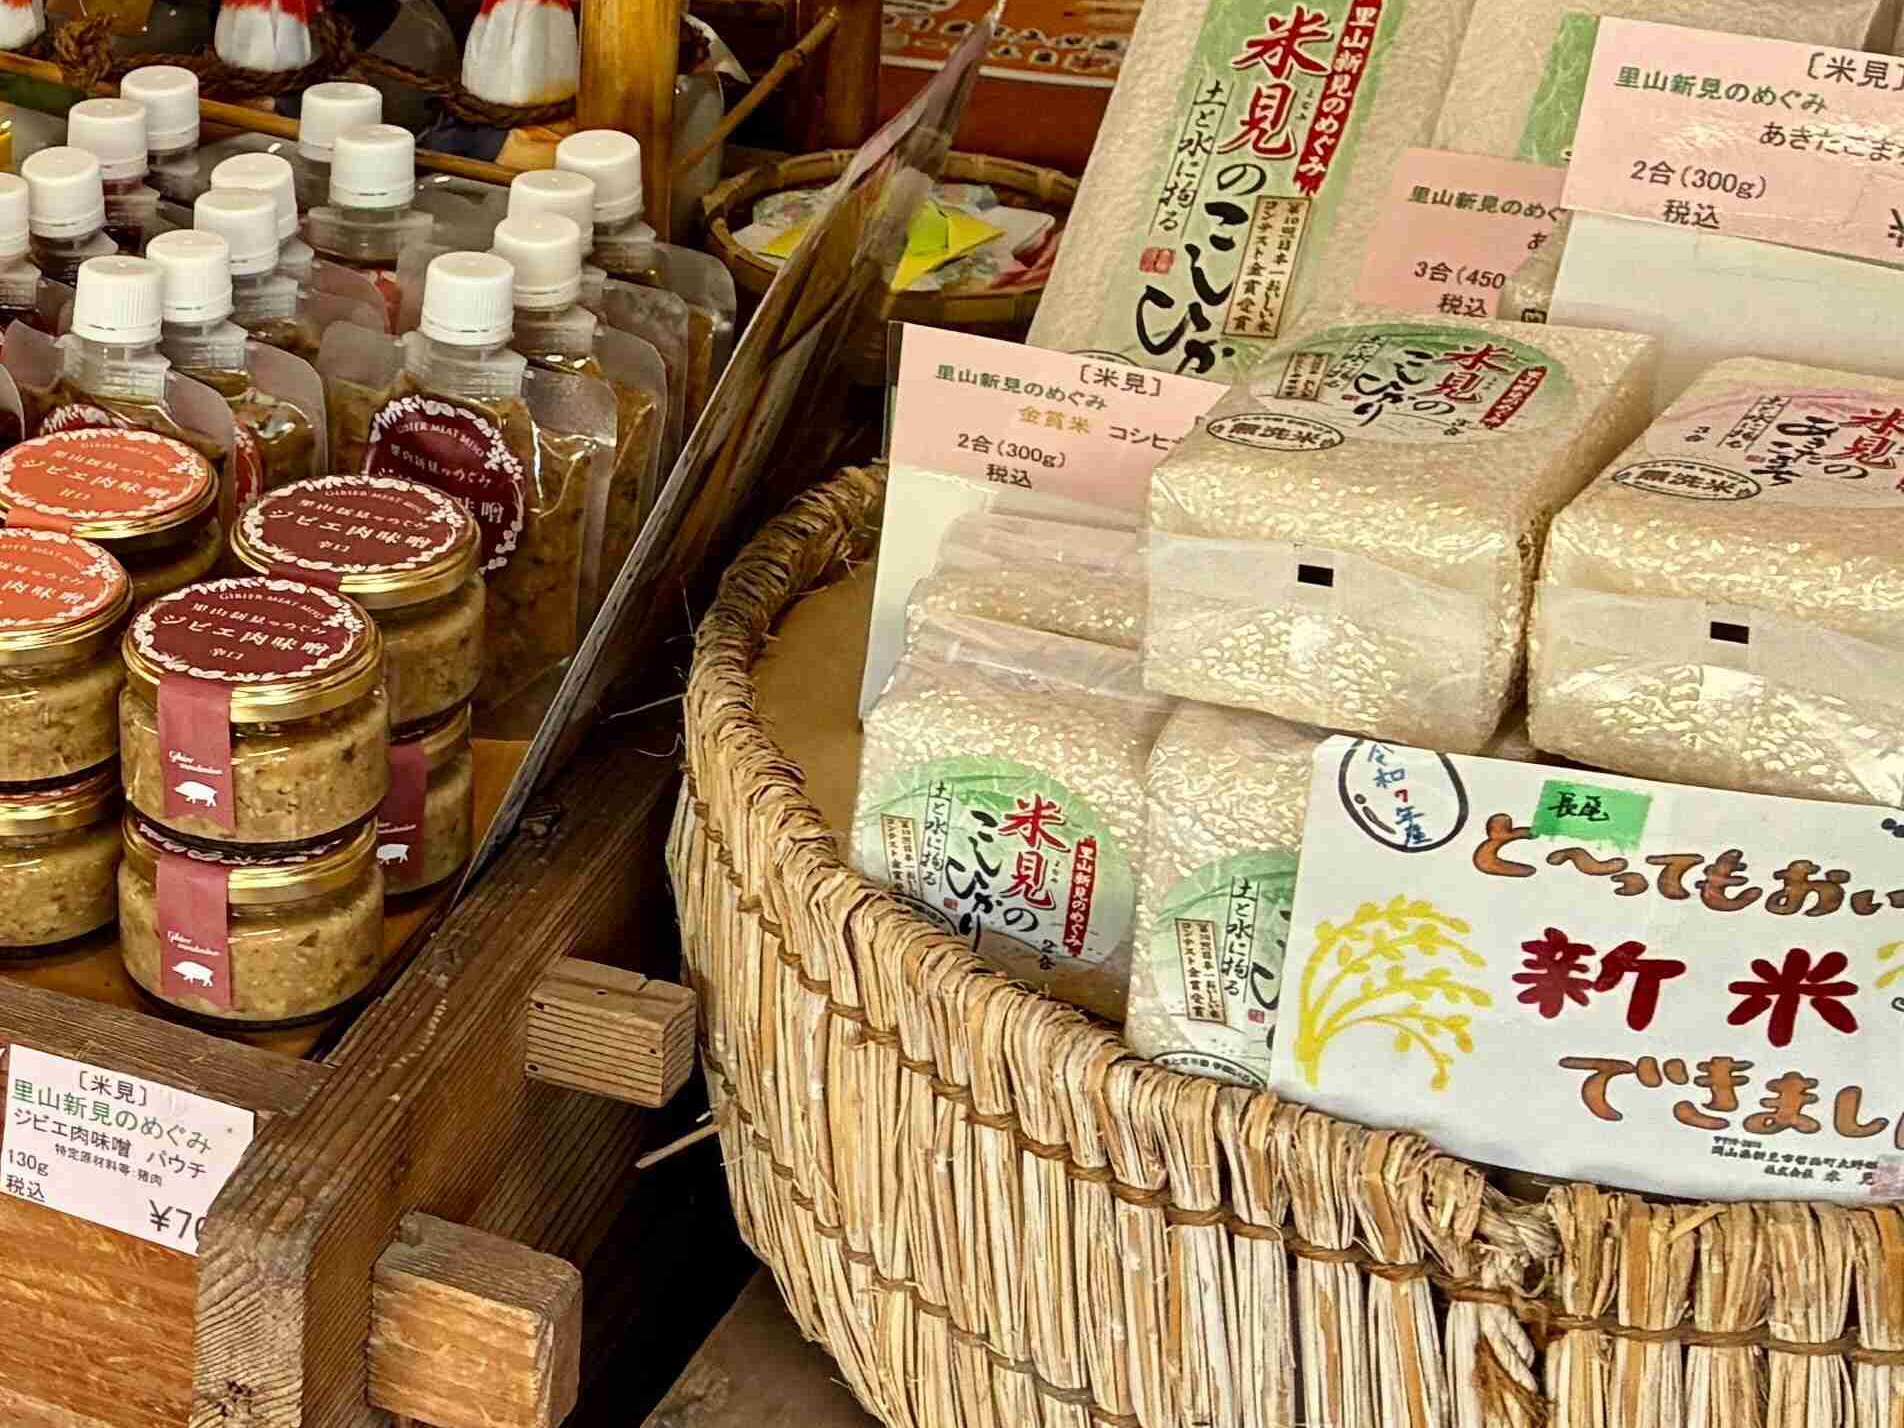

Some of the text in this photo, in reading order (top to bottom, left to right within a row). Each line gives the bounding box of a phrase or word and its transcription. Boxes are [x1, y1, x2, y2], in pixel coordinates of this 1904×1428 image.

[1614, 66, 1827, 114] 里山新見のめぐみ
[1663, 198, 1721, 230] 税込
[1437, 293, 1489, 319] 税込
[935, 363, 1106, 410] 里山新見のめぐみ
[986, 463, 1033, 489] 税込
[10, 1080, 212, 1155] 里山新見のめぐみ
[12, 1107, 207, 1179] ジビエ肉味噌 パウチ
[6, 1147, 50, 1176] 130g
[5, 1175, 47, 1203] 税込
